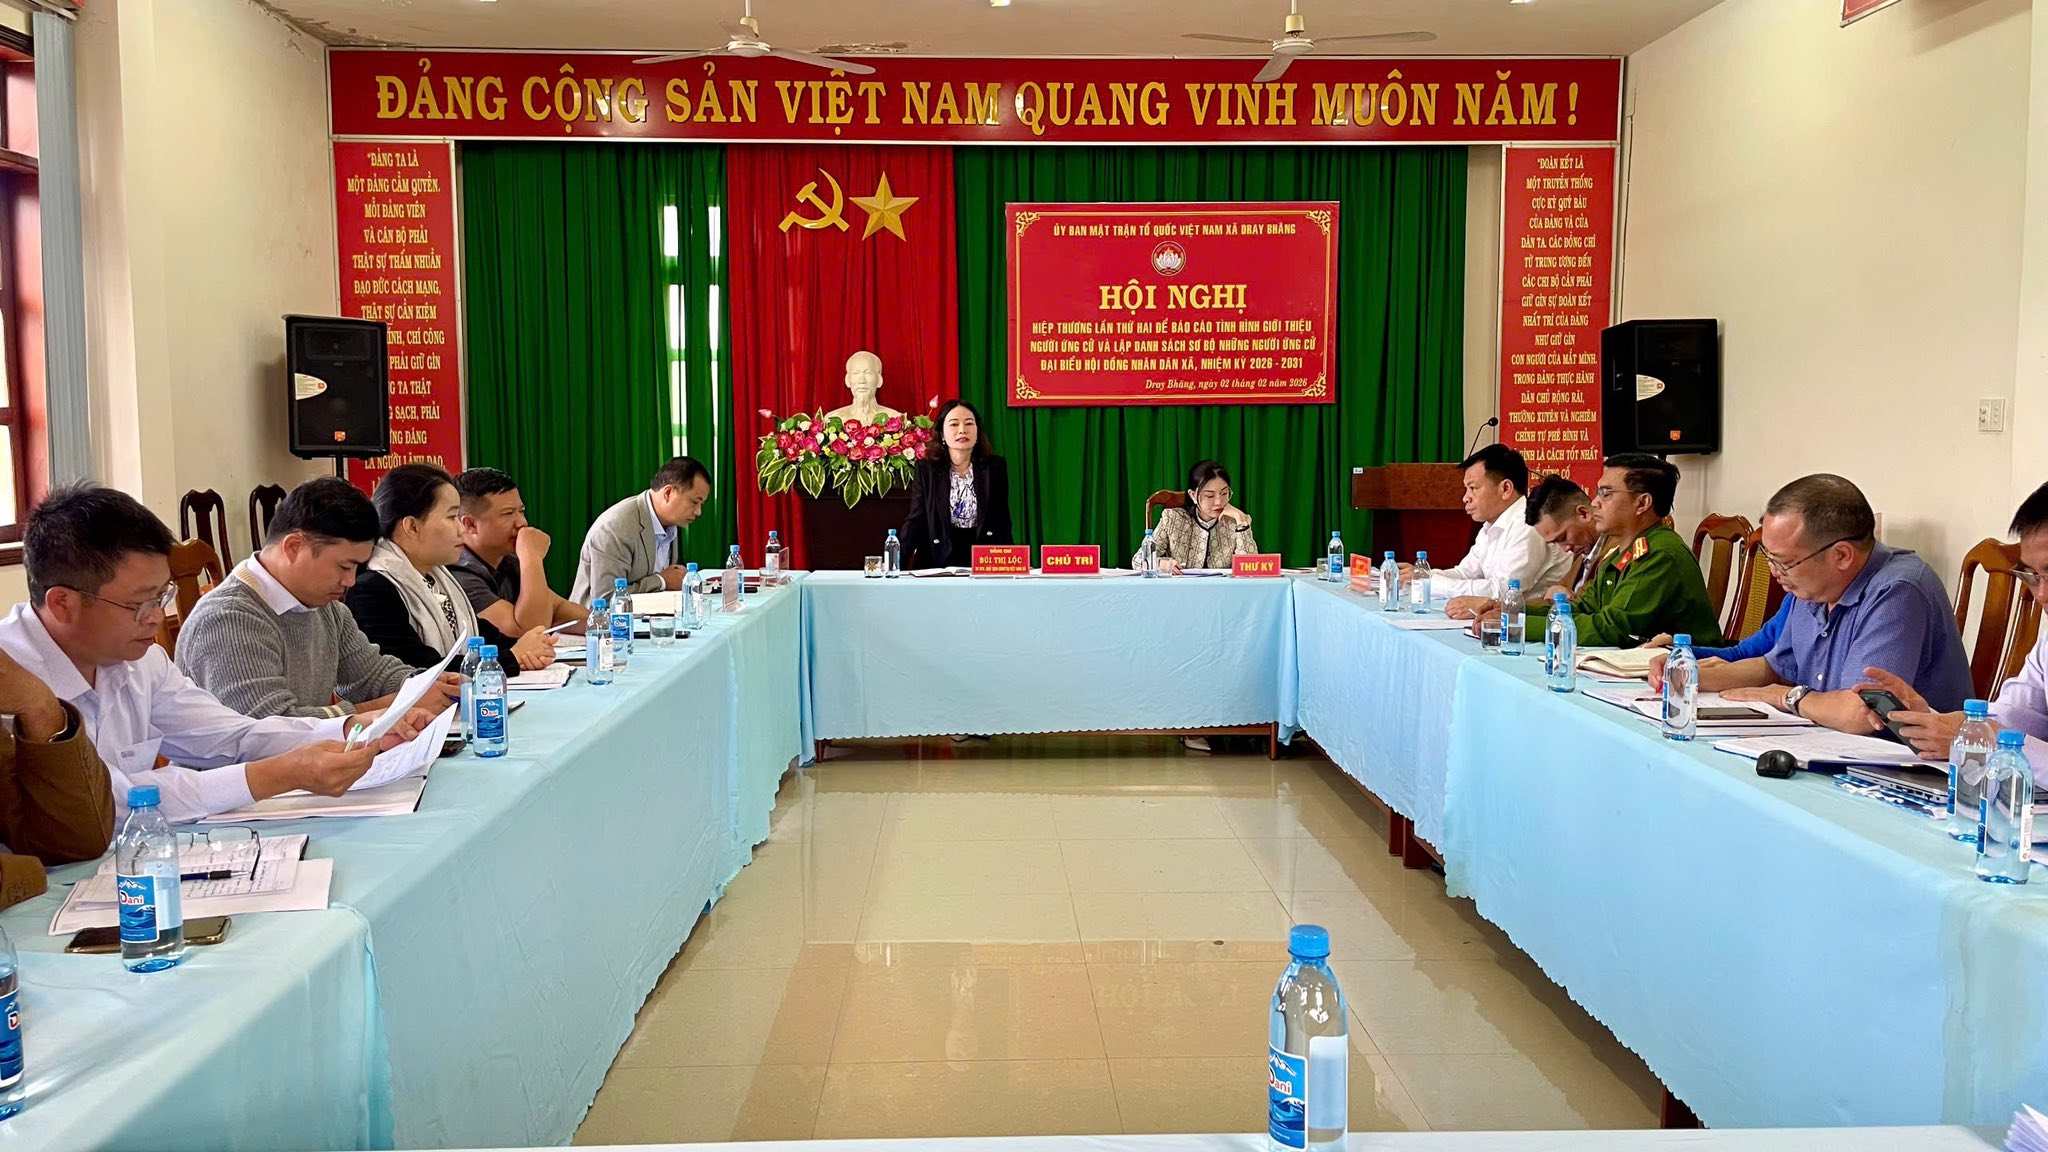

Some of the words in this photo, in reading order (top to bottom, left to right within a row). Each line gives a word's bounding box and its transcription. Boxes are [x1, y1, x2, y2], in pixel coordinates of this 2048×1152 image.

[375, 58, 508, 121] ĐẢNG
[521, 62, 649, 133] CỘNG
[665, 61, 759, 124] SẢN
[775, 69, 887, 135] VIỆT
[901, 81, 1001, 126] NAM
[1015, 80, 1170, 135] QUANG
[1184, 81, 1297, 126] VINH
[1311, 68, 1439, 126] MUÔN
[395, 153, 406, 167] TA
[408, 149, 419, 166] LÀ
[1575, 155, 1584, 168] LÀ
[348, 175, 365, 195] MỘT
[367, 173, 389, 192] ĐẢNG
[392, 171, 409, 192] CẦM
[383, 198, 404, 218] ĐẢNG
[406, 200, 426, 217] VIÊN
[1054, 223, 1066, 236] ỦY
[1069, 225, 1087, 236] BAN
[1113, 224, 1136, 238] TRẬN
[1154, 222, 1176, 237] QUỐC
[1180, 223, 1200, 237] VIỆT
[1203, 225, 1223, 235] NAM
[1226, 223, 1238, 235] XÃ
[1241, 224, 1264, 235] DRAY
[1565, 215, 1573, 228] VÀ
[364, 226, 375, 243] VÀ
[378, 226, 393, 243] CÁN
[396, 226, 406, 246] BỘ
[409, 225, 428, 243] PHẢI
[353, 251, 374, 272] THẬT
[376, 253, 387, 272] SỰ
[1535, 257, 1556, 268] TRUNG
[354, 280, 370, 297] ĐẠO
[373, 277, 389, 294] ĐỨC
[392, 277, 413, 294] CÁCH
[1538, 277, 1549, 287] CHI
[1099, 278, 1156, 315] HỘI
[1168, 284, 1247, 315] NGHỊ
[385, 304, 395, 323] SỰ
[416, 302, 436, 322] KIỆM
[407, 327, 421, 344] CHÍ
[423, 328, 444, 344] CÔNG
[1032, 320, 1054, 336] HIỆP
[1057, 321, 1092, 334] THƯƠNG
[1137, 322, 1152, 334] HAI
[1171, 320, 1190, 333] BÁO
[1194, 320, 1212, 332] CÁO
[1216, 319, 1236, 332] TÌNH
[1239, 319, 1260, 332] HÌNH
[1285, 319, 1312, 334] THIỆU
[1030, 339, 1058, 352] NGƯỜI
[1098, 339, 1110, 352] VÀ
[1114, 339, 1131, 354] LẬP
[1134, 341, 1158, 352] DANH
[1162, 338, 1186, 352] SÁCH
[1189, 339, 1200, 351] SƠ
[1204, 338, 1215, 353] BỘ
[427, 352, 441, 369] GÌN
[1041, 359, 1056, 372] ĐẠI
[1084, 358, 1100, 373] HỘI
[1131, 357, 1156, 370] NHÂN
[1160, 357, 1178, 370] DÂN
[1201, 356, 1231, 372] NHIỆM
[1250, 358, 1272, 369] 2026
[1281, 357, 1302, 368] 2031
[1511, 354, 1525, 365] CON
[398, 381, 408, 394] TA
[410, 377, 431, 397] THẬT
[1258, 379, 1267, 387] 02
[1289, 378, 1308, 386] 2026
[1514, 374, 1535, 384] TRONG
[421, 400, 440, 419] PHẢI
[1047, 554, 1071, 565] CHỦ
[1074, 555, 1093, 565] TRÌ
[1239, 562, 1259, 571] THƯ
[119, 890, 144, 905] Dani
